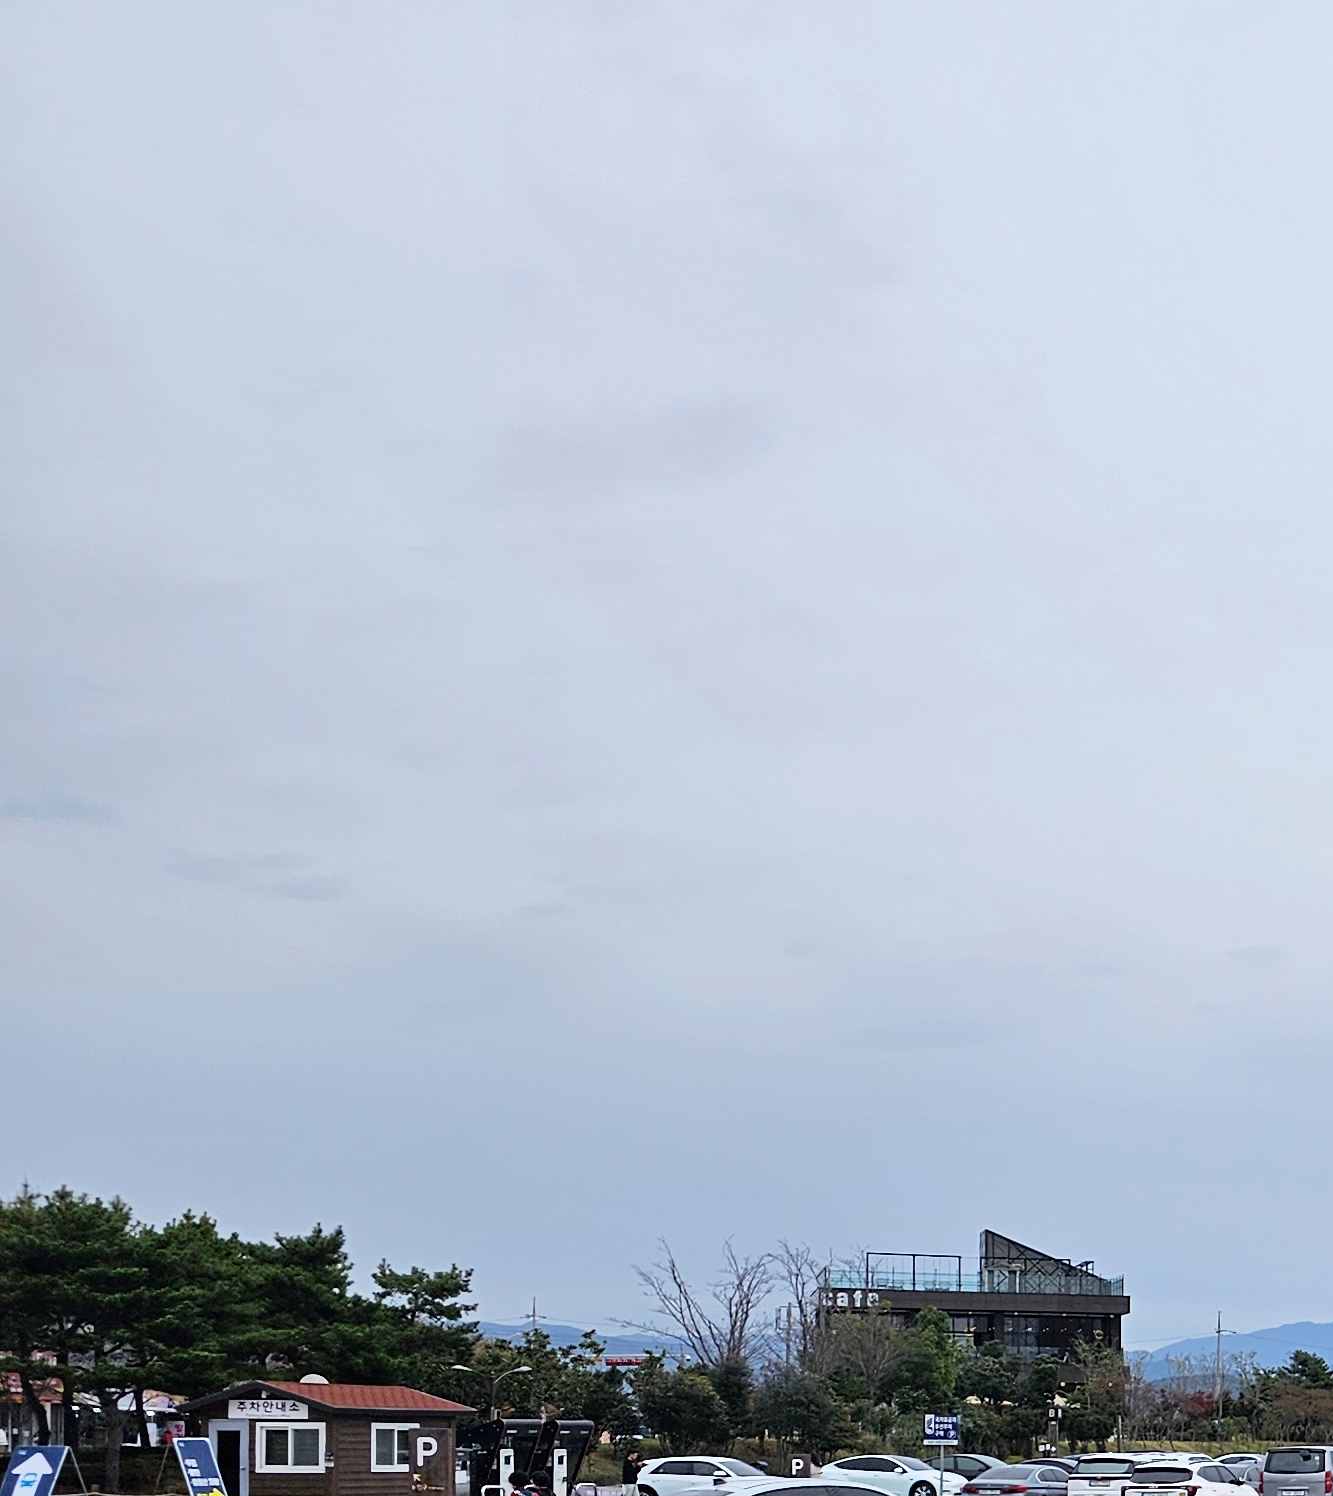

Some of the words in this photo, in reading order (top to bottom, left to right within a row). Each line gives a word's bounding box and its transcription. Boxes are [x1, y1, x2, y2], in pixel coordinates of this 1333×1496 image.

[236, 1401, 300, 1413] 주차안내소
[417, 1436, 438, 1467] P
[791, 1458, 804, 1475] P
